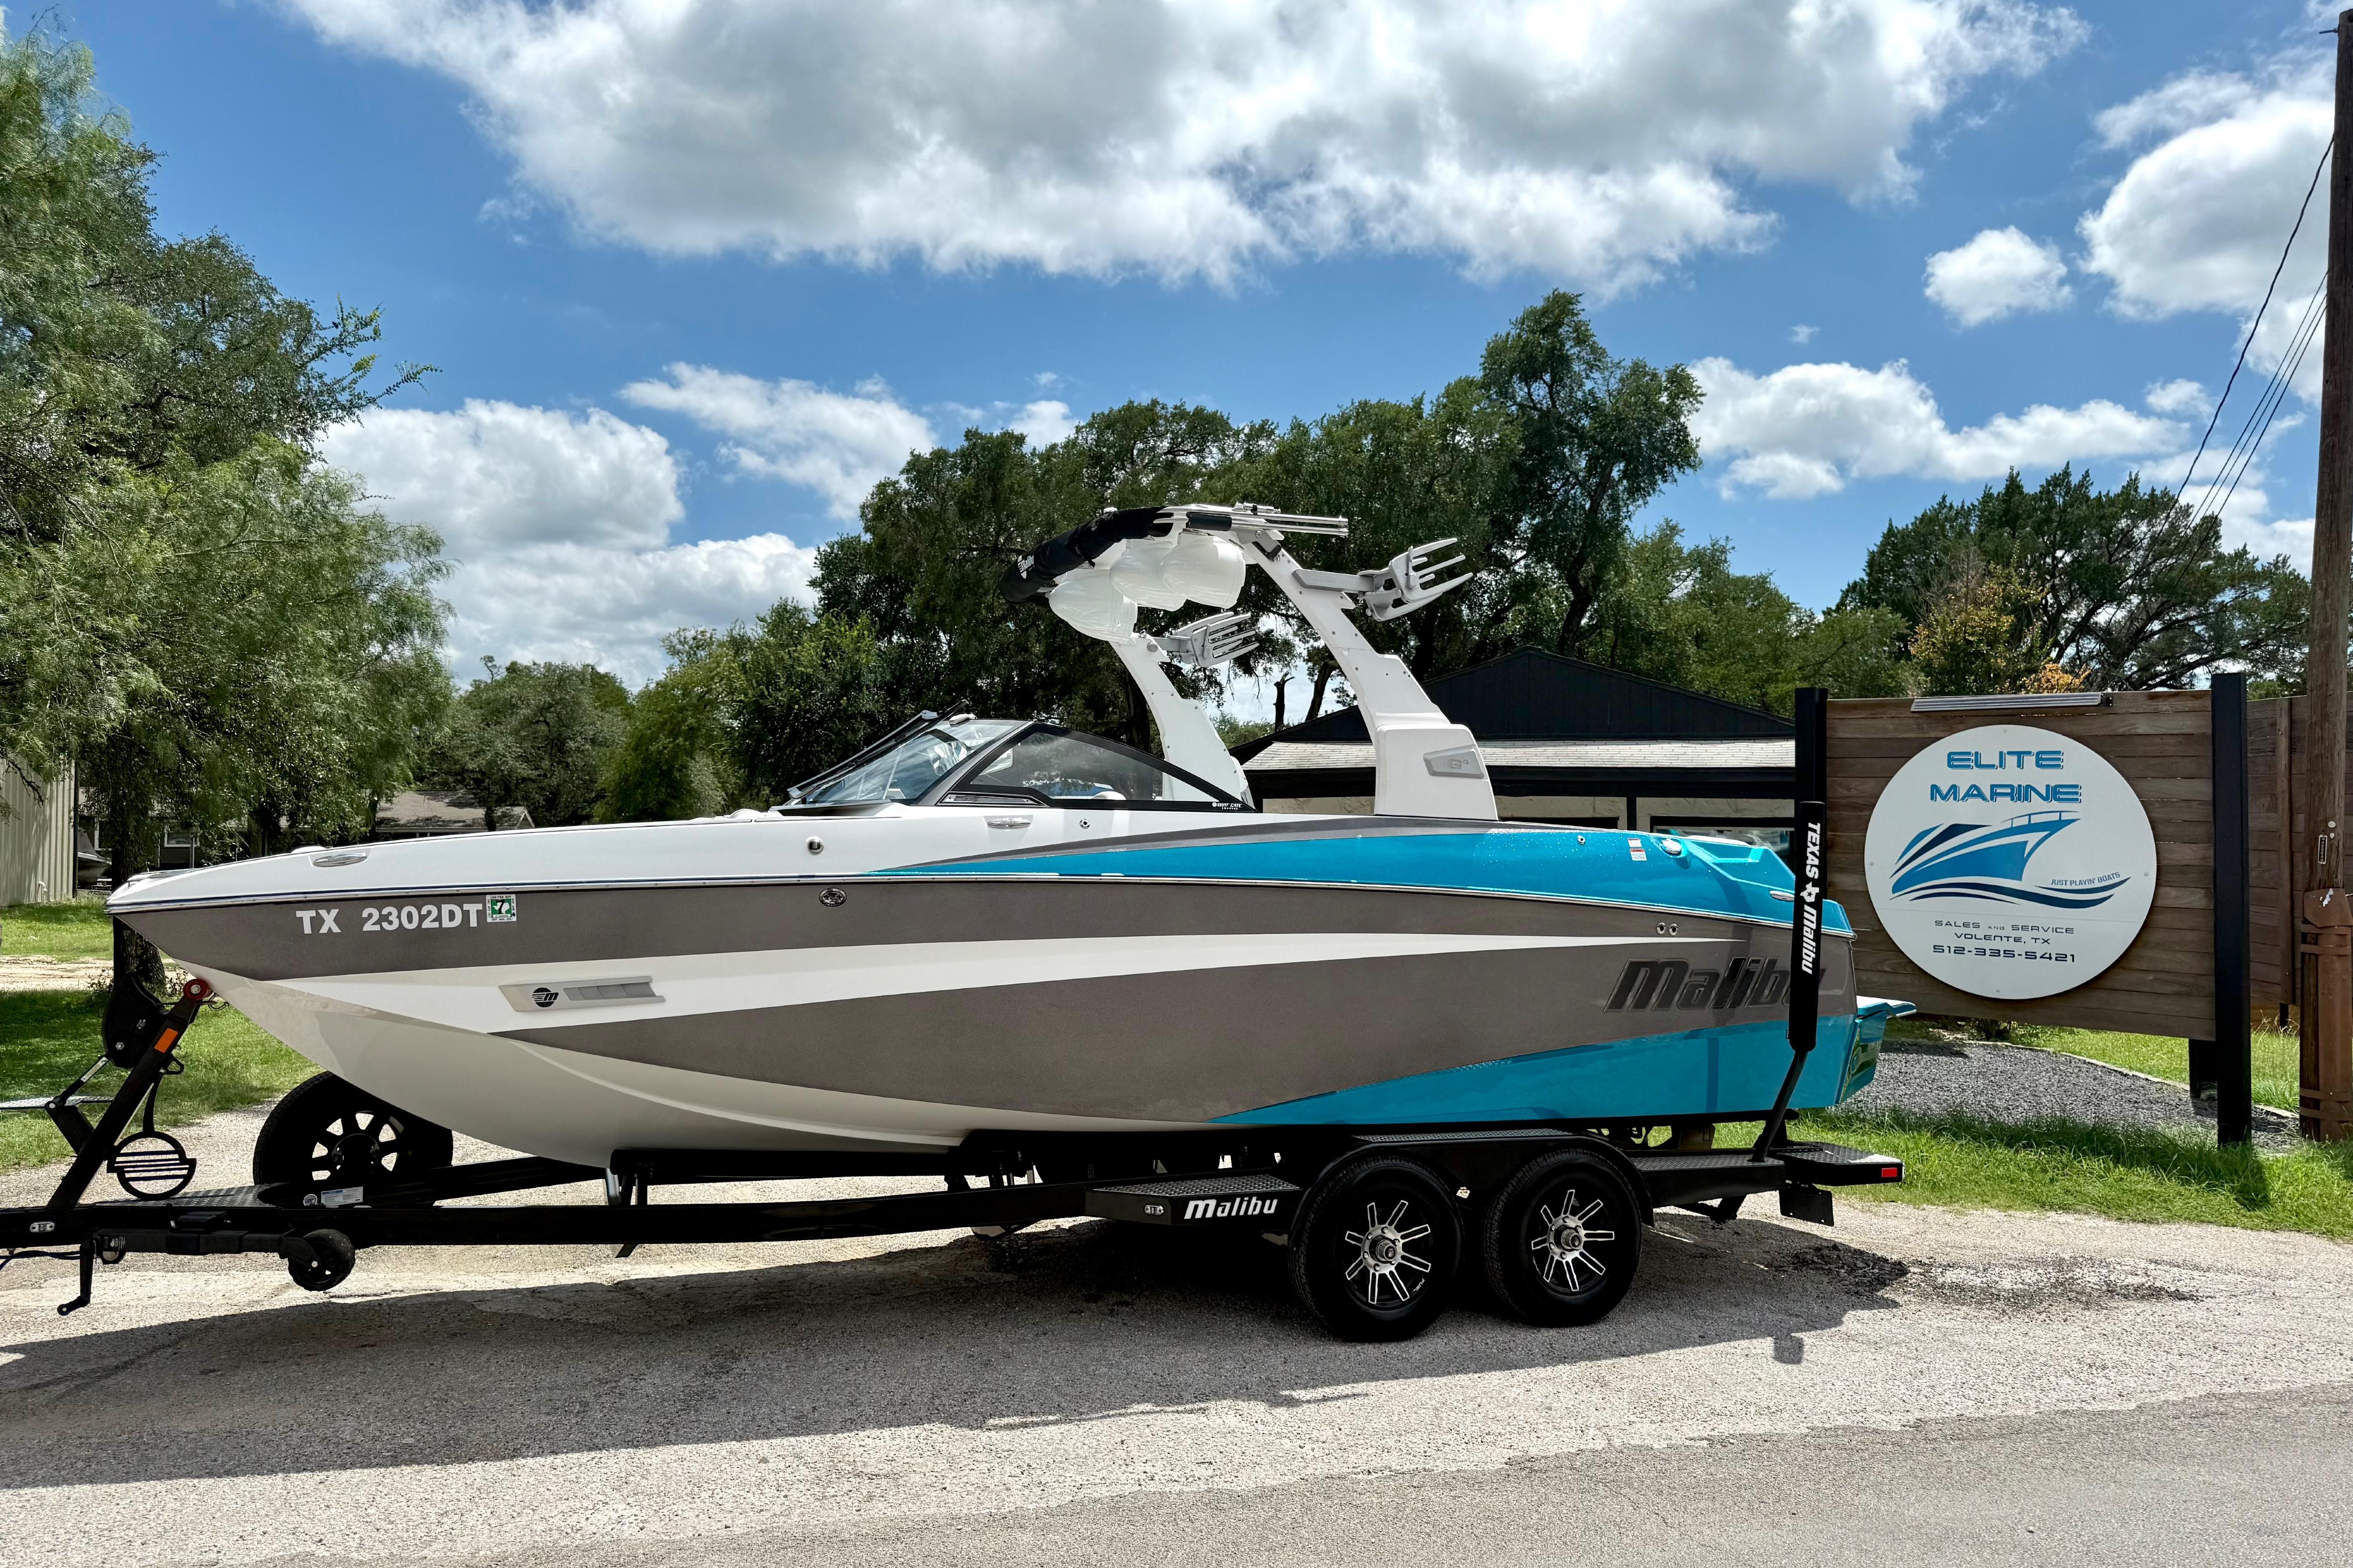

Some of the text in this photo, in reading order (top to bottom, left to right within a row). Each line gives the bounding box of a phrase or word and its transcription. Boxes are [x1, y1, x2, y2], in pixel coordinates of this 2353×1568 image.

[1947, 750, 2063, 770] ELITE
[1930, 784, 2081, 803] MARINE
[1806, 822, 1821, 880] TEXAS
[2070, 878, 2096, 886] PLAYIN'
[2097, 872, 2120, 883] BOATS
[296, 909, 341, 934] TX
[362, 903, 483, 932] 2302DT
[2012, 925, 2074, 934] SERVICE
[1933, 945, 2075, 963] 512-335-5421
